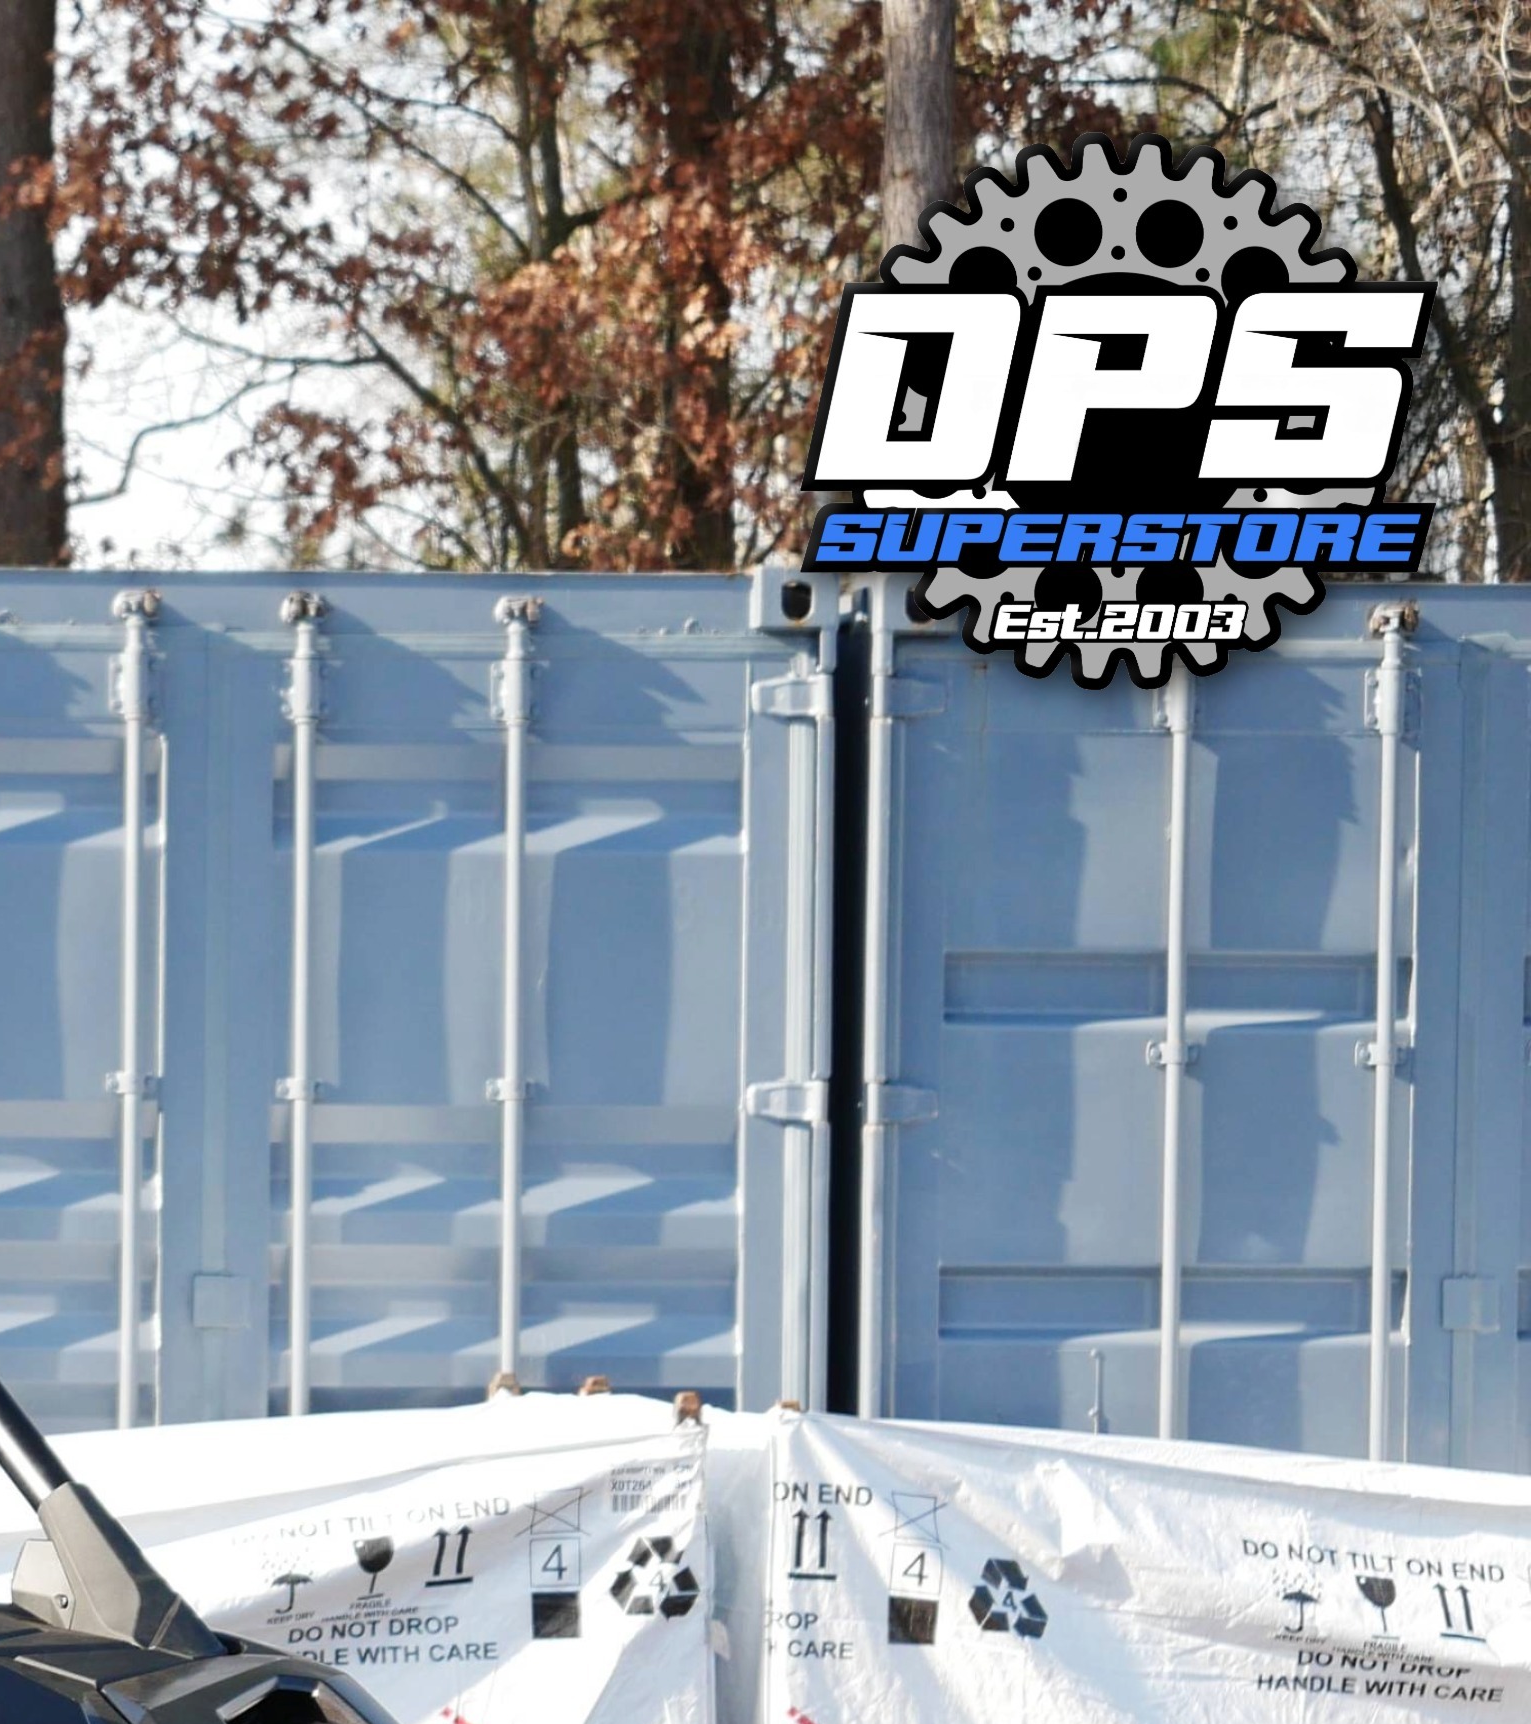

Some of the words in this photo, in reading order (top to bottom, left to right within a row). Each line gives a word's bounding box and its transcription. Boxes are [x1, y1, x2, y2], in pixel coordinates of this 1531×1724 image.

[774, 1482, 809, 1503] ON
[818, 1483, 873, 1506] END
[407, 1503, 446, 1524] ON
[456, 1497, 511, 1519] END
[541, 1544, 567, 1581] 4
[902, 1552, 928, 1586] 4
[1242, 1539, 1279, 1559] DO
[1288, 1542, 1337, 1566] NOT
[1347, 1551, 1397, 1573] TILT
[1406, 1558, 1443, 1577] ON
[1451, 1562, 1505, 1582] END
[1002, 1591, 1017, 1612] 4
[288, 1625, 323, 1644] DO
[330, 1620, 382, 1640] NOT
[389, 1616, 460, 1636] DROP
[357, 1645, 420, 1665] WITH
[429, 1641, 499, 1662] CARE
[787, 1639, 854, 1660] CARE
[1297, 1650, 1333, 1666] DO
[1341, 1655, 1391, 1671] NOT
[1400, 1661, 1471, 1678] DROP
[1257, 1674, 1356, 1694] HANDLE
[1365, 1679, 1426, 1698] WITH
[1434, 1683, 1504, 1703] CARE
